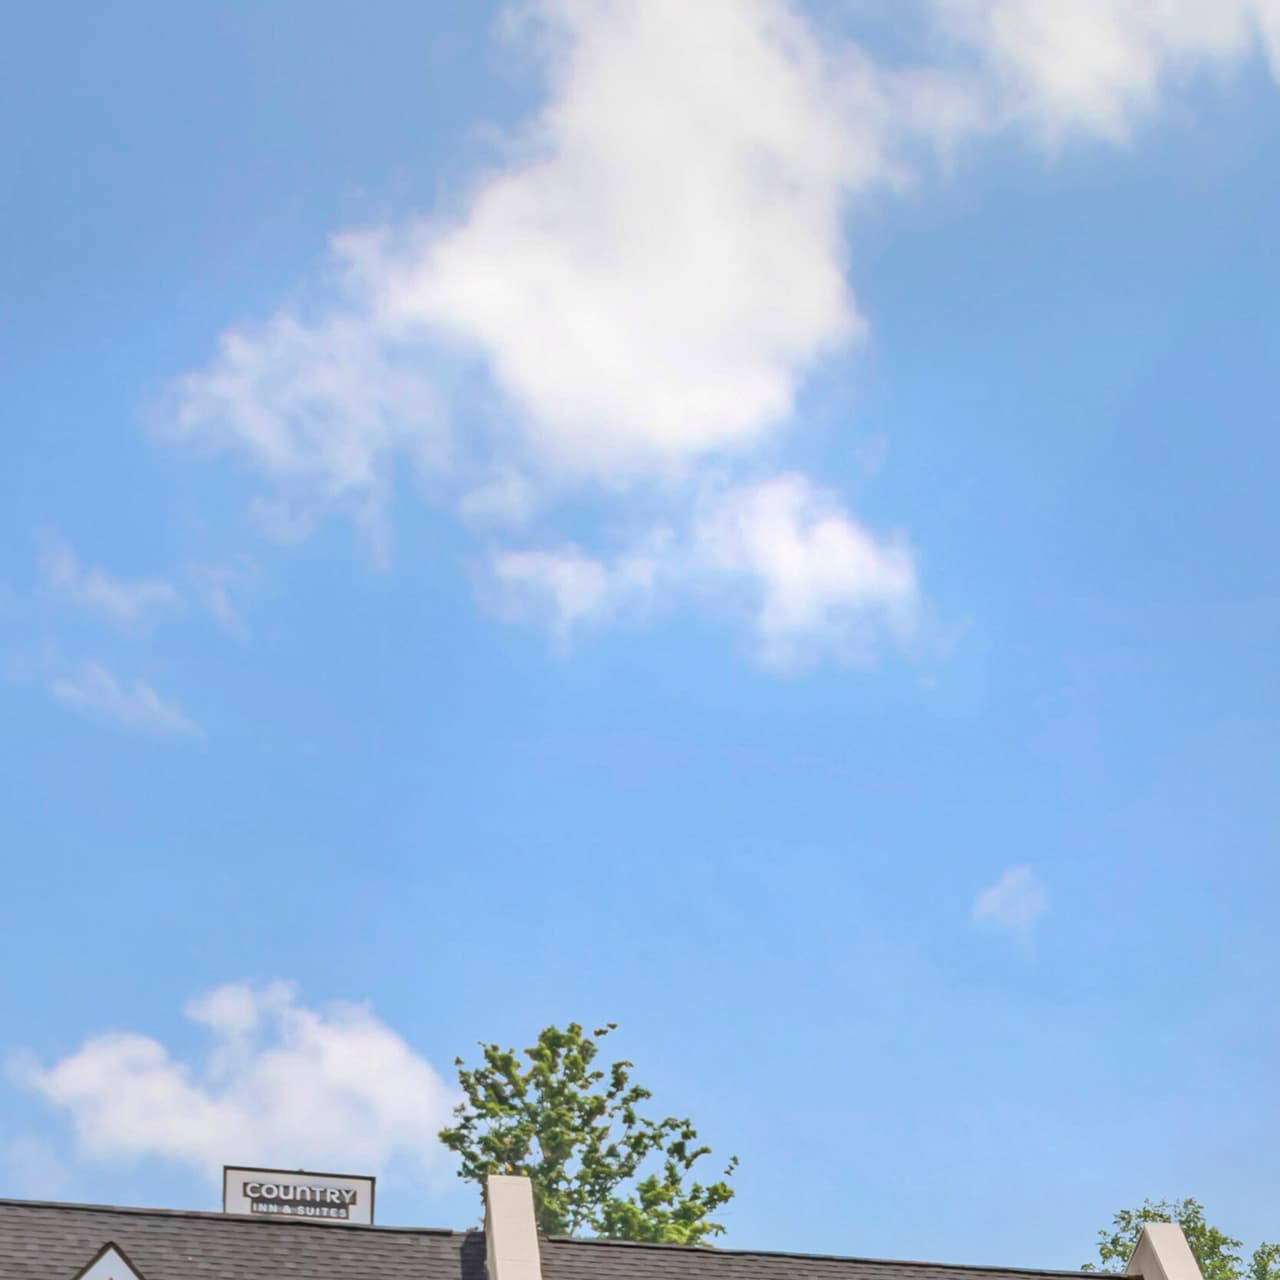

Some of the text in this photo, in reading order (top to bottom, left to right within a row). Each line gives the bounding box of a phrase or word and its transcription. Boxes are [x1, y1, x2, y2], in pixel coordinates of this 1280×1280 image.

[246, 1183, 355, 1204] COUNTRY
[252, 1203, 347, 1217] INN & SUITES
